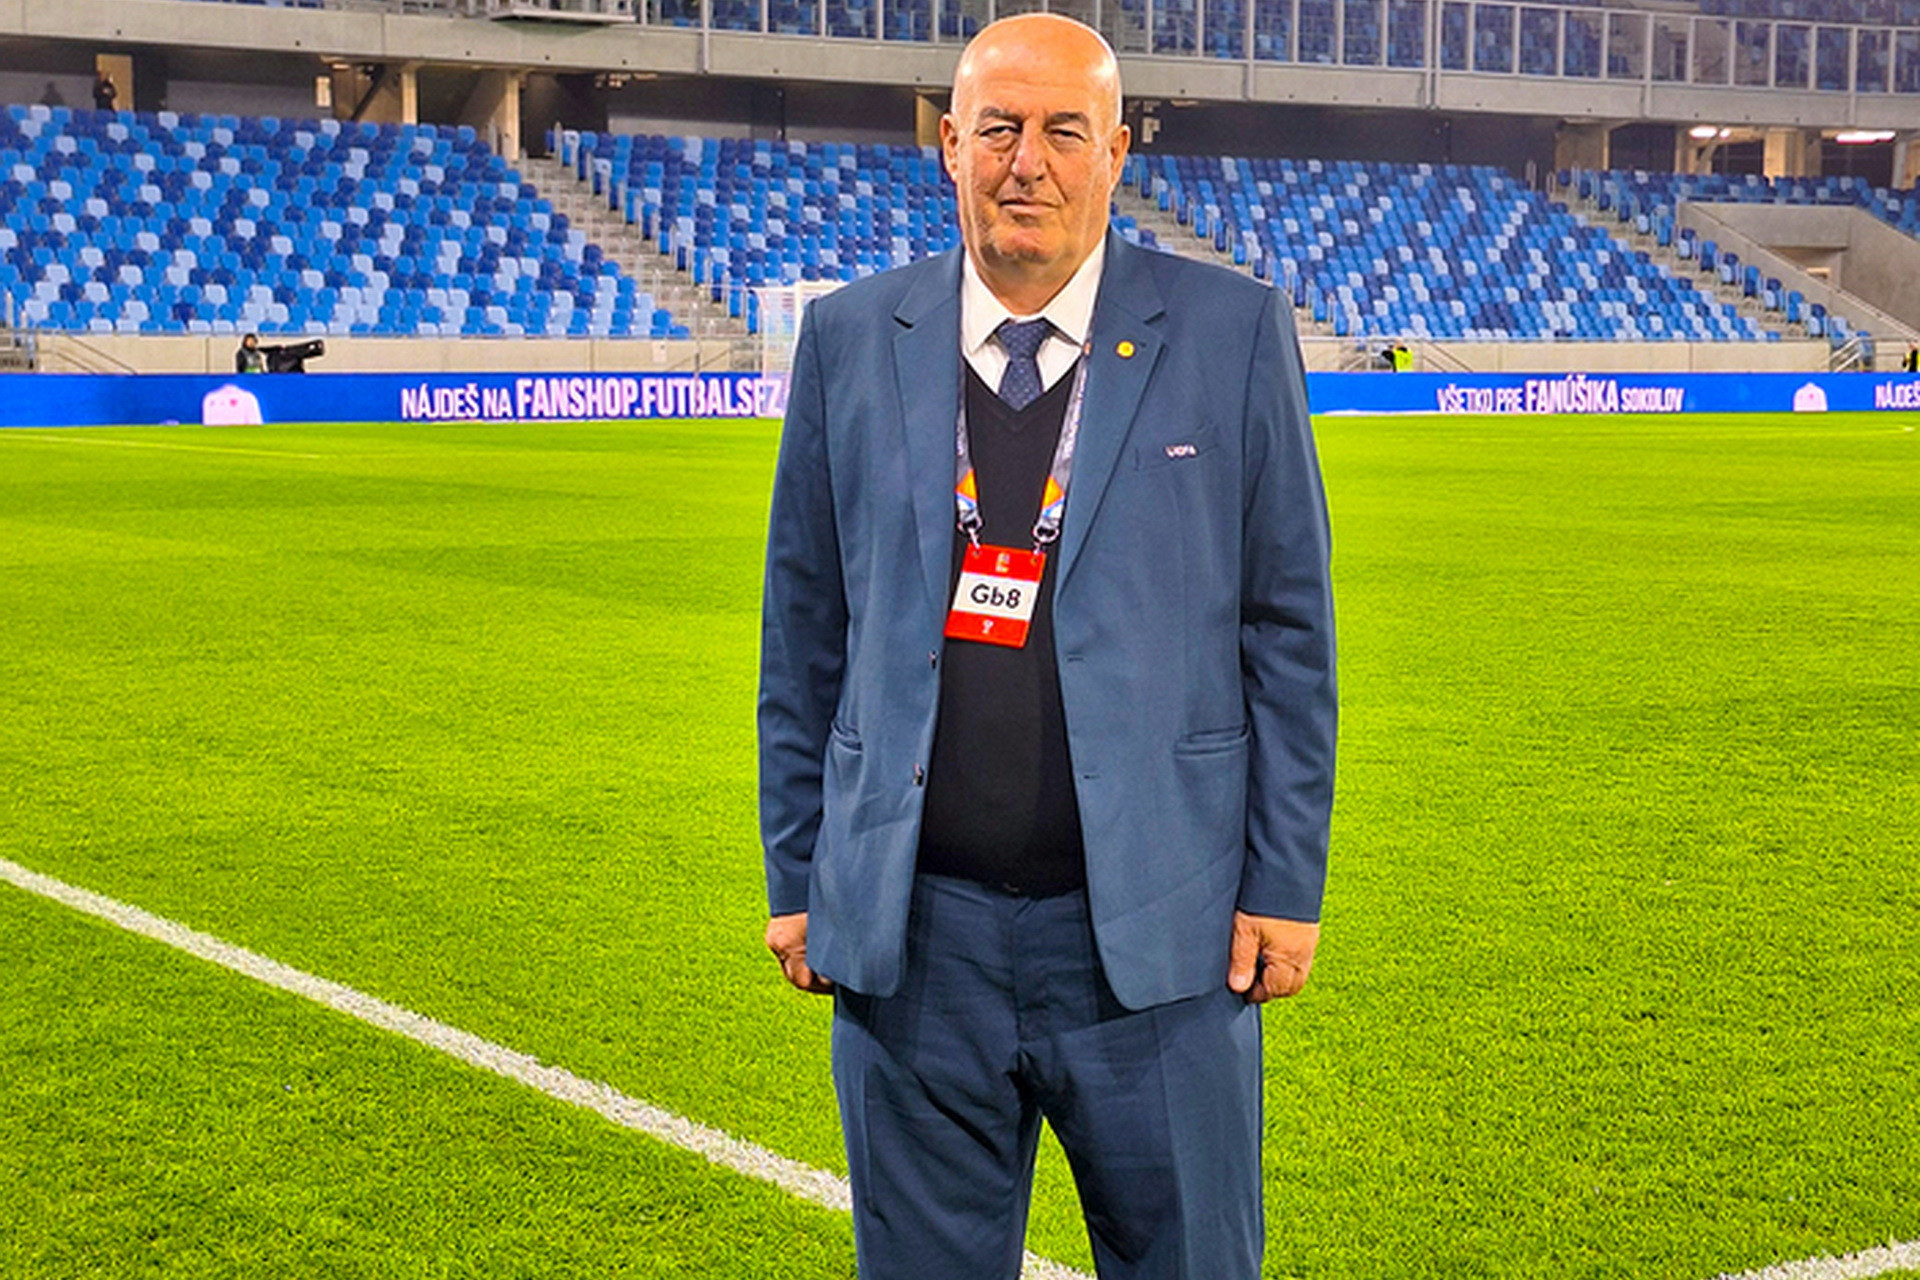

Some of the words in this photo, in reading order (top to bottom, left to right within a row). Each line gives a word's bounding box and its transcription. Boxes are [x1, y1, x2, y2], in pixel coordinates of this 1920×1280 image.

[402, 383, 479, 418] NÁJDEŠ
[483, 388, 513, 418] NA
[1495, 388, 1524, 413] PRE
[1525, 374, 1618, 413] FANÚŠIKA
[1621, 388, 1684, 412] SOKOLOV
[970, 583, 1021, 609] Gb8
